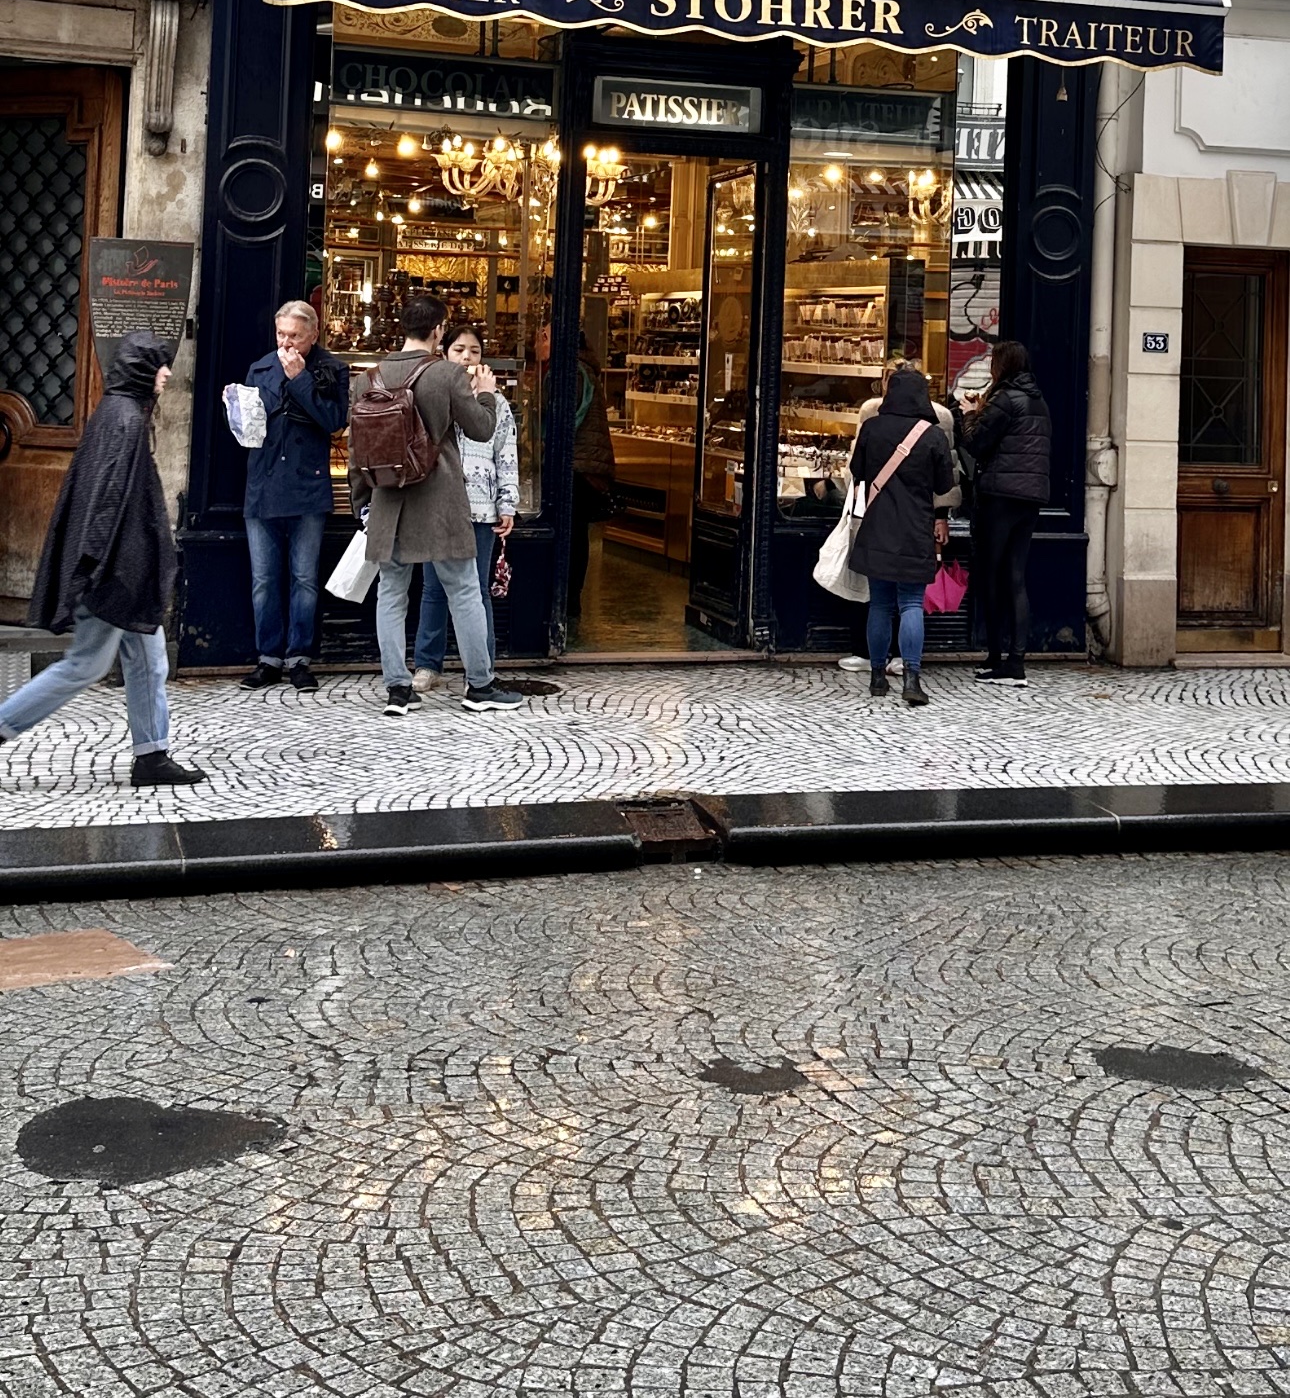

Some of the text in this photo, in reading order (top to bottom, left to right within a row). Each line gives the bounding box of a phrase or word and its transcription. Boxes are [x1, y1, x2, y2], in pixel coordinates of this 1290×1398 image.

[1014, 14, 1197, 58] TRAITEUR
[340, 62, 548, 100] CHOCOLATS
[610, 91, 741, 126] PATISSIER
[154, 278, 178, 289] Paris
[1146, 335, 1165, 350] 53
